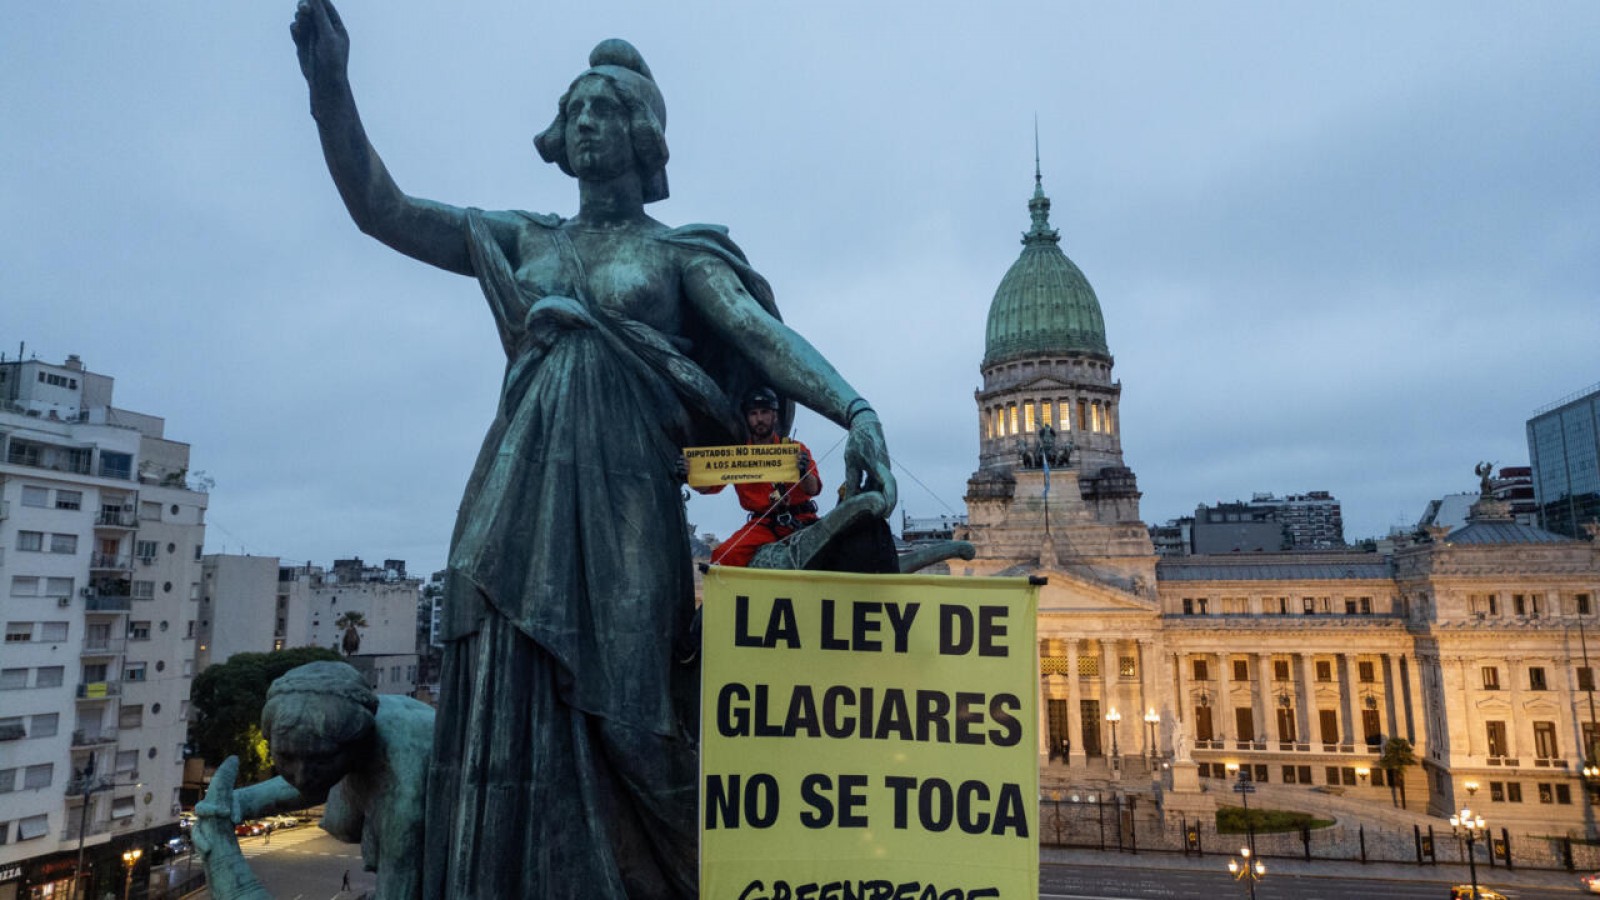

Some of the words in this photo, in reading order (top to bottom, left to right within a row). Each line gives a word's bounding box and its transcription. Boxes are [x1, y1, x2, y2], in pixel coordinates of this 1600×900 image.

[686, 449, 734, 458] DIPUTADOS:
[736, 447, 749, 456] NO
[751, 446, 799, 456] TRAICIONEN
[705, 461, 712, 469] A
[714, 461, 729, 469] LOS
[731, 459, 782, 469] ARGENTINOS
[735, 595, 801, 649] LA
[821, 599, 920, 653] LEY
[940, 604, 1009, 657] DE
[717, 683, 1022, 747] GLACIARES
[705, 773, 780, 830] NO
[800, 773, 868, 829] SE
[885, 776, 1029, 838] TOCA
